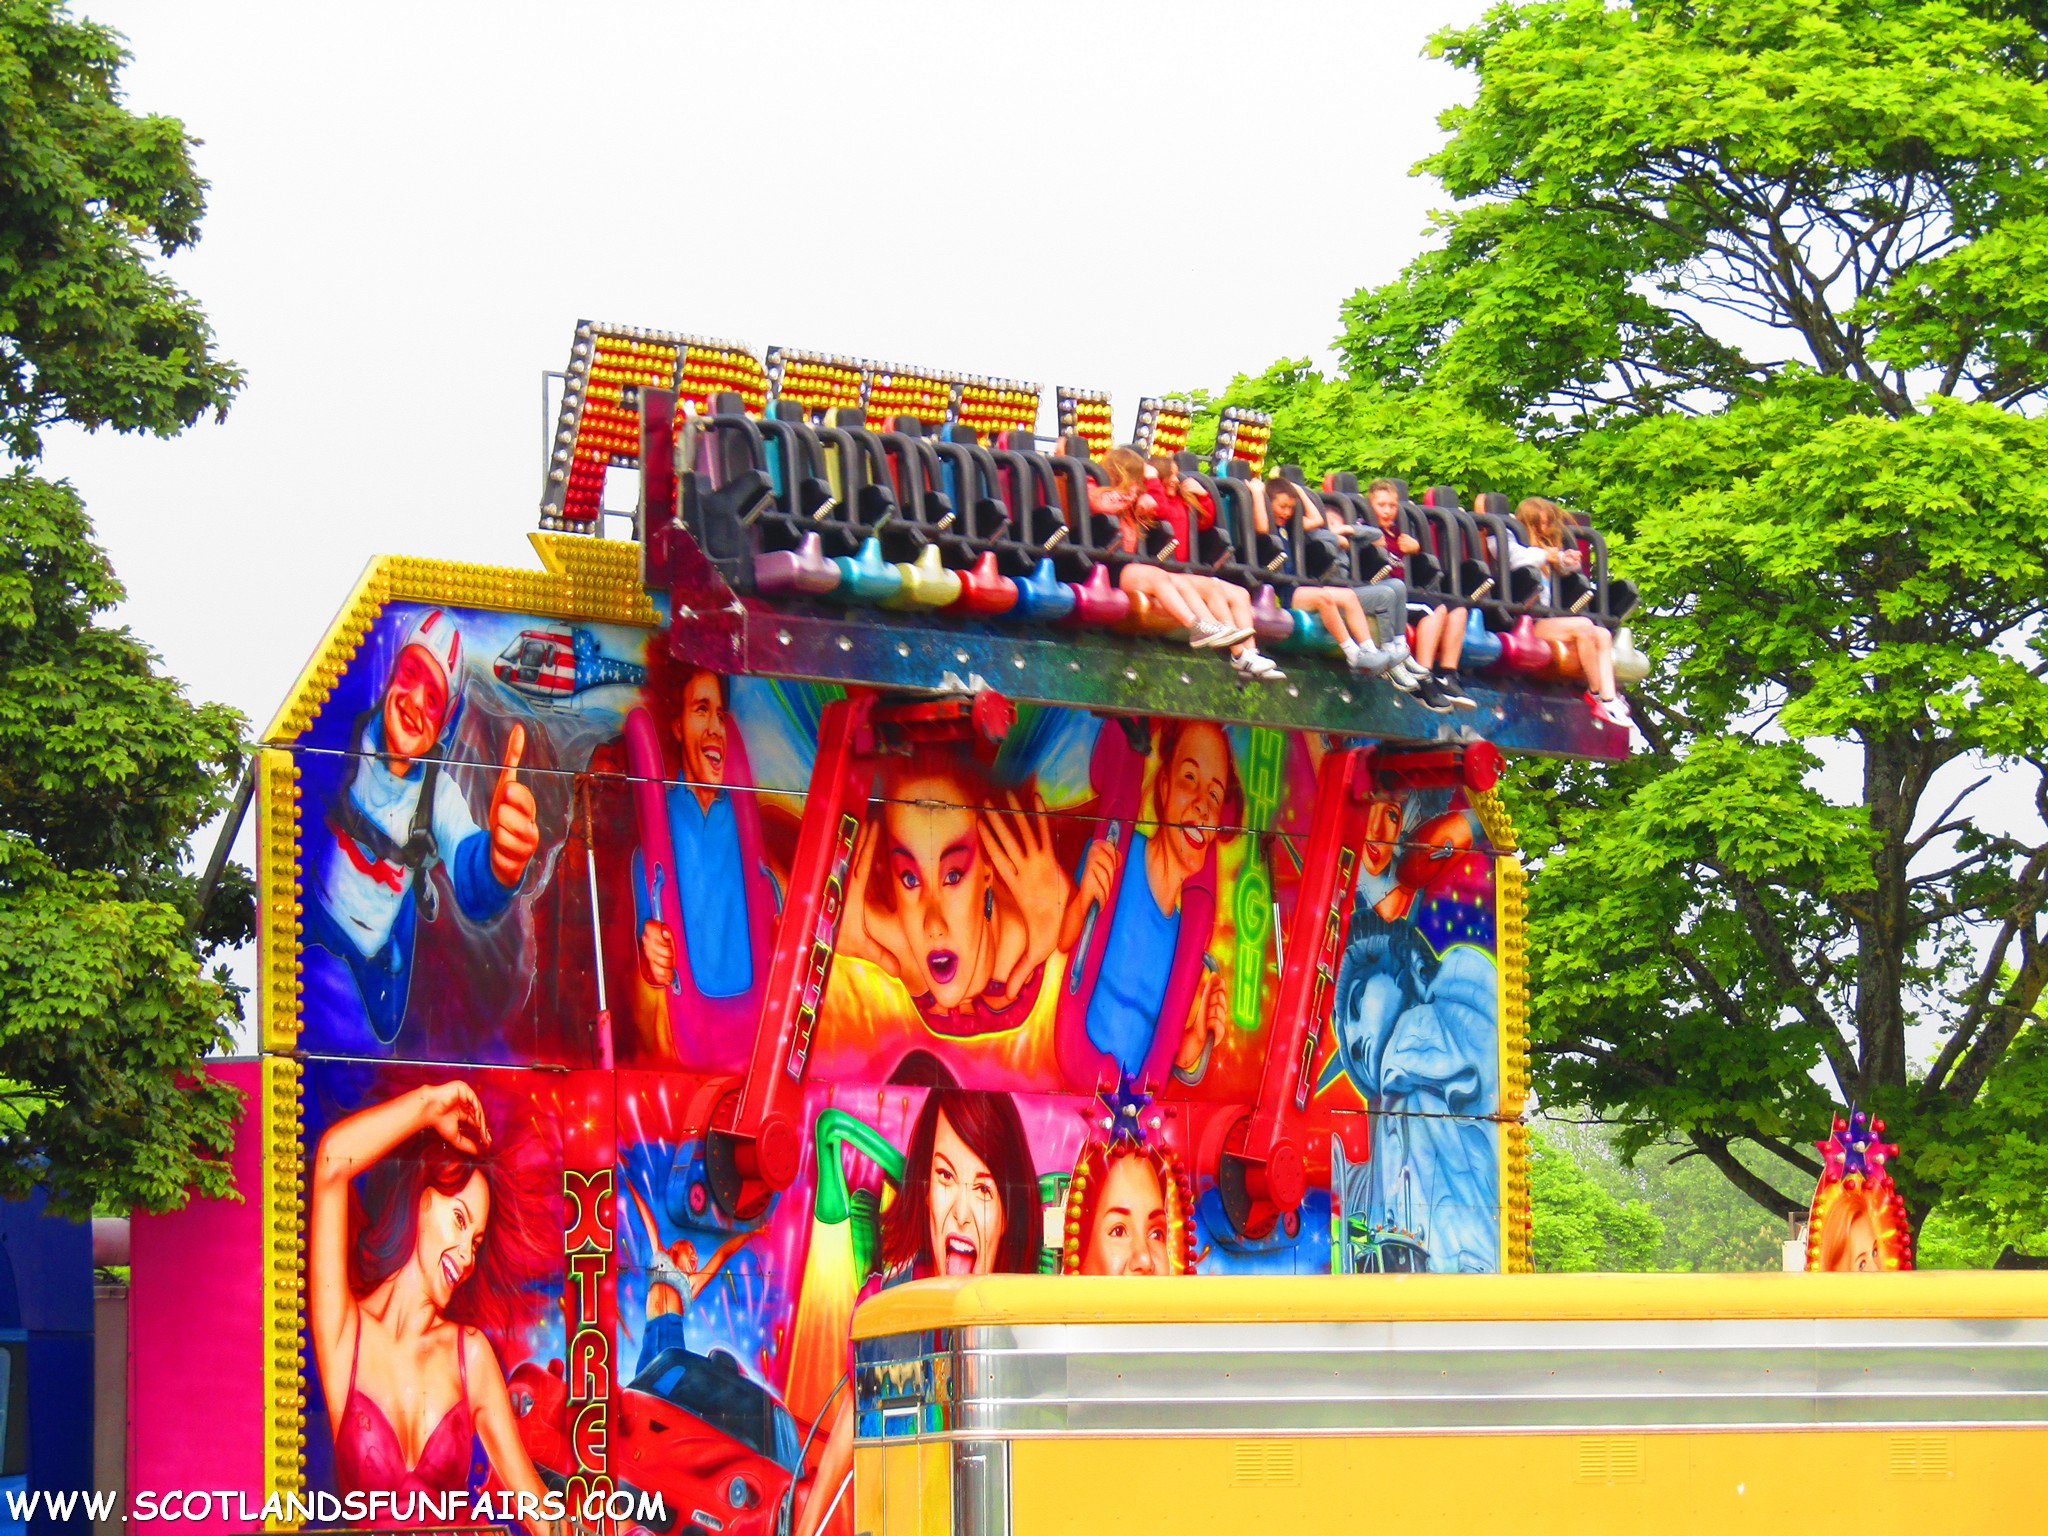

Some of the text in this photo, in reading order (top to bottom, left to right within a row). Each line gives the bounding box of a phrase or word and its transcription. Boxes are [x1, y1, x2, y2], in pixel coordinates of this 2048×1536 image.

[787, 813, 858, 1079] FREE
[1235, 727, 1284, 1021] HIGH
[1296, 846, 1356, 1106] FALL
